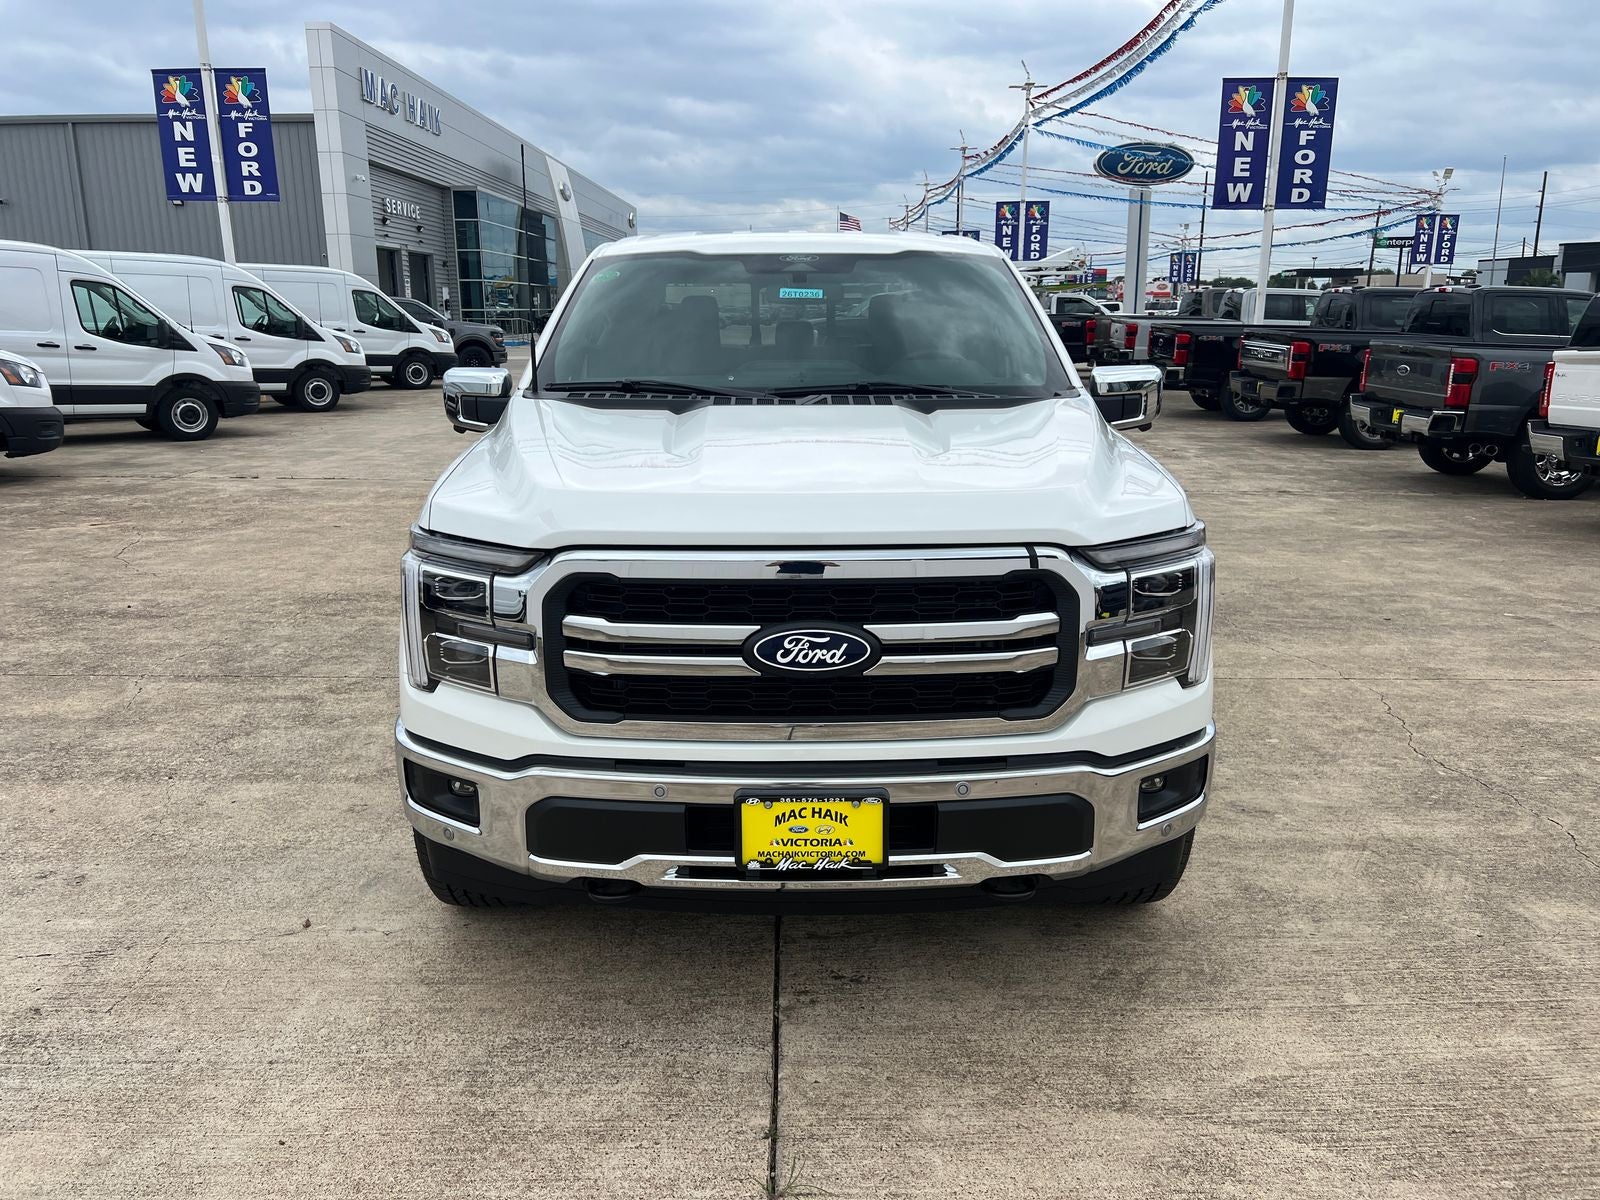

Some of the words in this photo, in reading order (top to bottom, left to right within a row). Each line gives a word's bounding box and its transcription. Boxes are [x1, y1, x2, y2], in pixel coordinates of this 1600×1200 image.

[360, 67, 400, 115] MAC
[404, 91, 442, 136] HAIK
[172, 121, 203, 193] NEW
[237, 122, 263, 196] FORD
[1117, 149, 1174, 175] Ford
[1226, 131, 1255, 203] NEW
[1290, 130, 1316, 203] FORD
[385, 198, 421, 220] SERVICE
[1030, 225, 1041, 260] FORD
[1379, 239, 1415, 247] enterpr
[1416, 234, 1428, 262] NEW
[1440, 234, 1451, 263] FORD
[781, 290, 820, 298] 26T0236
[1318, 343, 1351, 352] FX4
[1489, 361, 1532, 372] FX4
[776, 635, 849, 664] Ford
[774, 807, 807, 828] MAC
[811, 807, 849, 828] HAIK
[757, 850, 866, 858] MACHAIKVICTORIA.COM
[780, 838, 843, 847] VICTORIA
[775, 857, 808, 871] Mac
[813, 857, 852, 871] Haik
